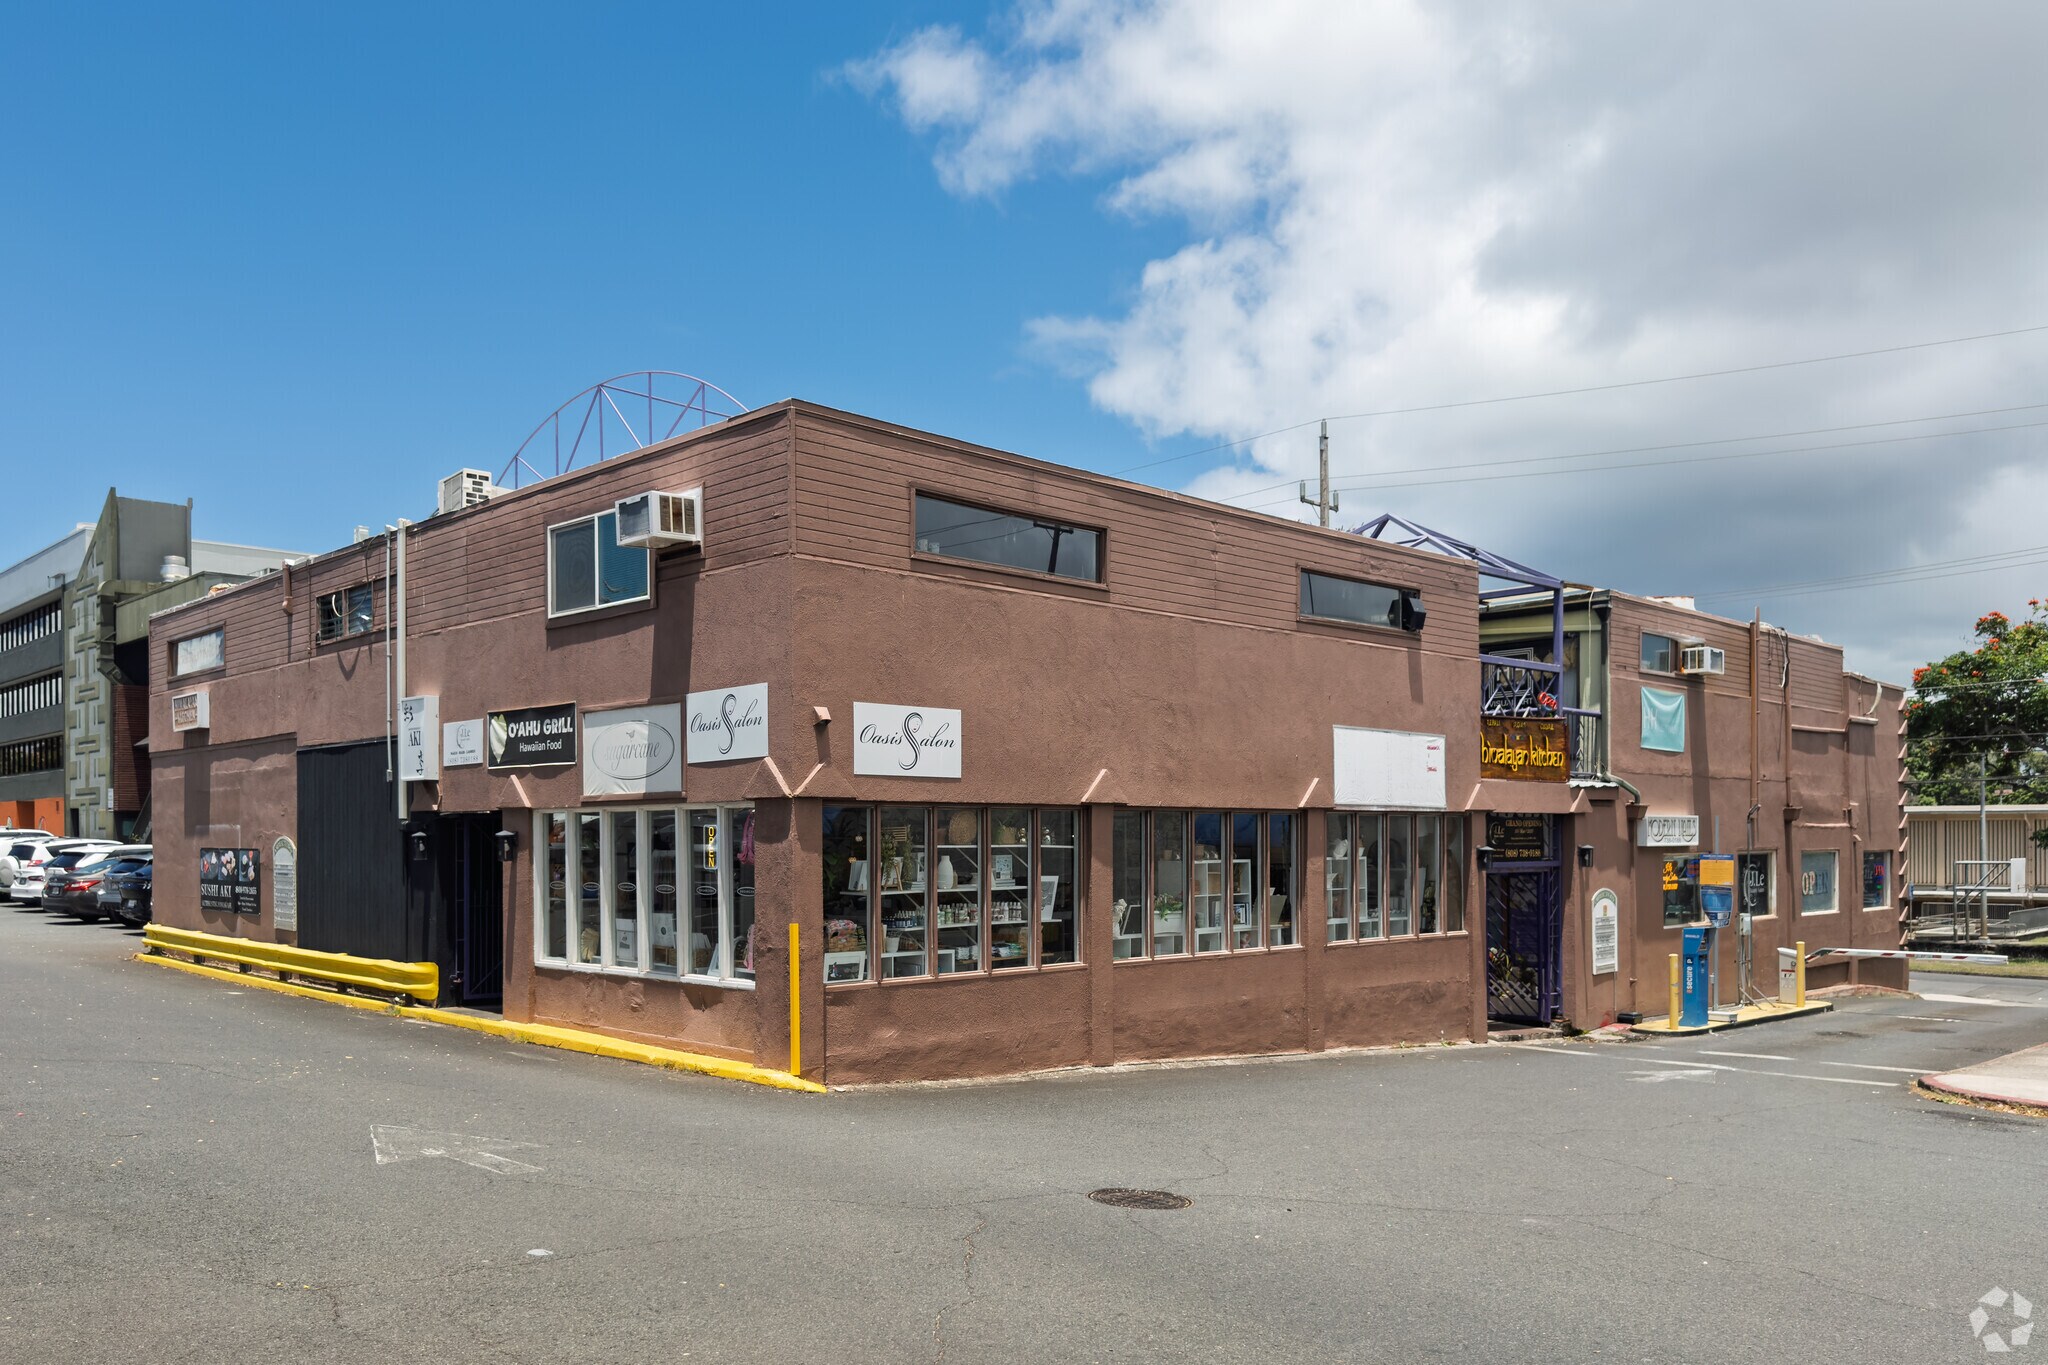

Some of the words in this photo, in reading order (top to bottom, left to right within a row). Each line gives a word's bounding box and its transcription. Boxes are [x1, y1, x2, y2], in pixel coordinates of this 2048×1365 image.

[507, 719, 541, 738] O'AHU
[543, 716, 573, 735] GRILL
[691, 712, 721, 733] Oasis
[718, 693, 763, 755] Salon
[408, 730, 421, 747] AKI
[519, 741, 546, 752] Hawaiian
[546, 738, 562, 750] Food
[860, 723, 904, 746] Oasis
[898, 712, 957, 771] Salon
[1480, 731, 1529, 772] himalayan
[1529, 734, 1564, 767] kitchen
[603, 741, 660, 771] sugarcane
[201, 883, 218, 896] SUSHI
[220, 885, 231, 897] AKI
